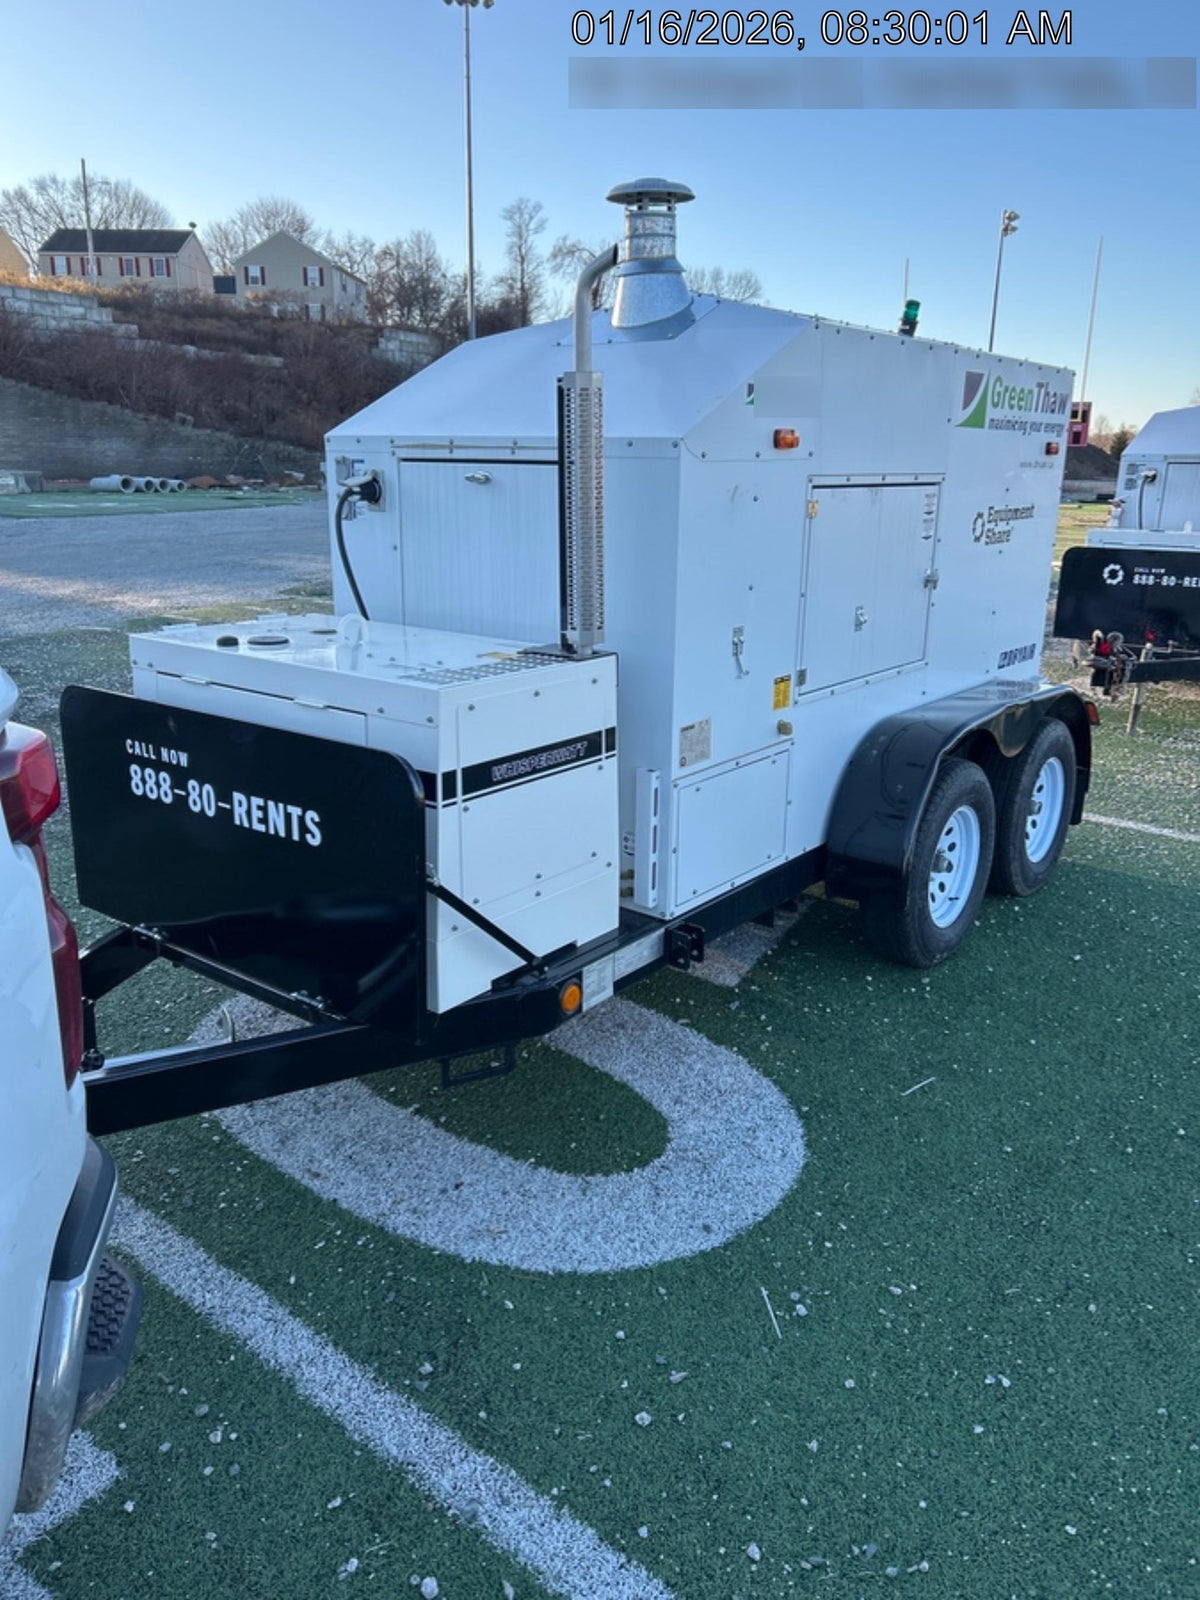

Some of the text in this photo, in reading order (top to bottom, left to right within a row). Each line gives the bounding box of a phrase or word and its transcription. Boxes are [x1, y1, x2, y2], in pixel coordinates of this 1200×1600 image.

[987, 504, 1035, 527] Equipment
[985, 529, 1011, 546] Share
[125, 738, 189, 768] CALL NOW
[129, 763, 323, 847] 888-80-RENTS
